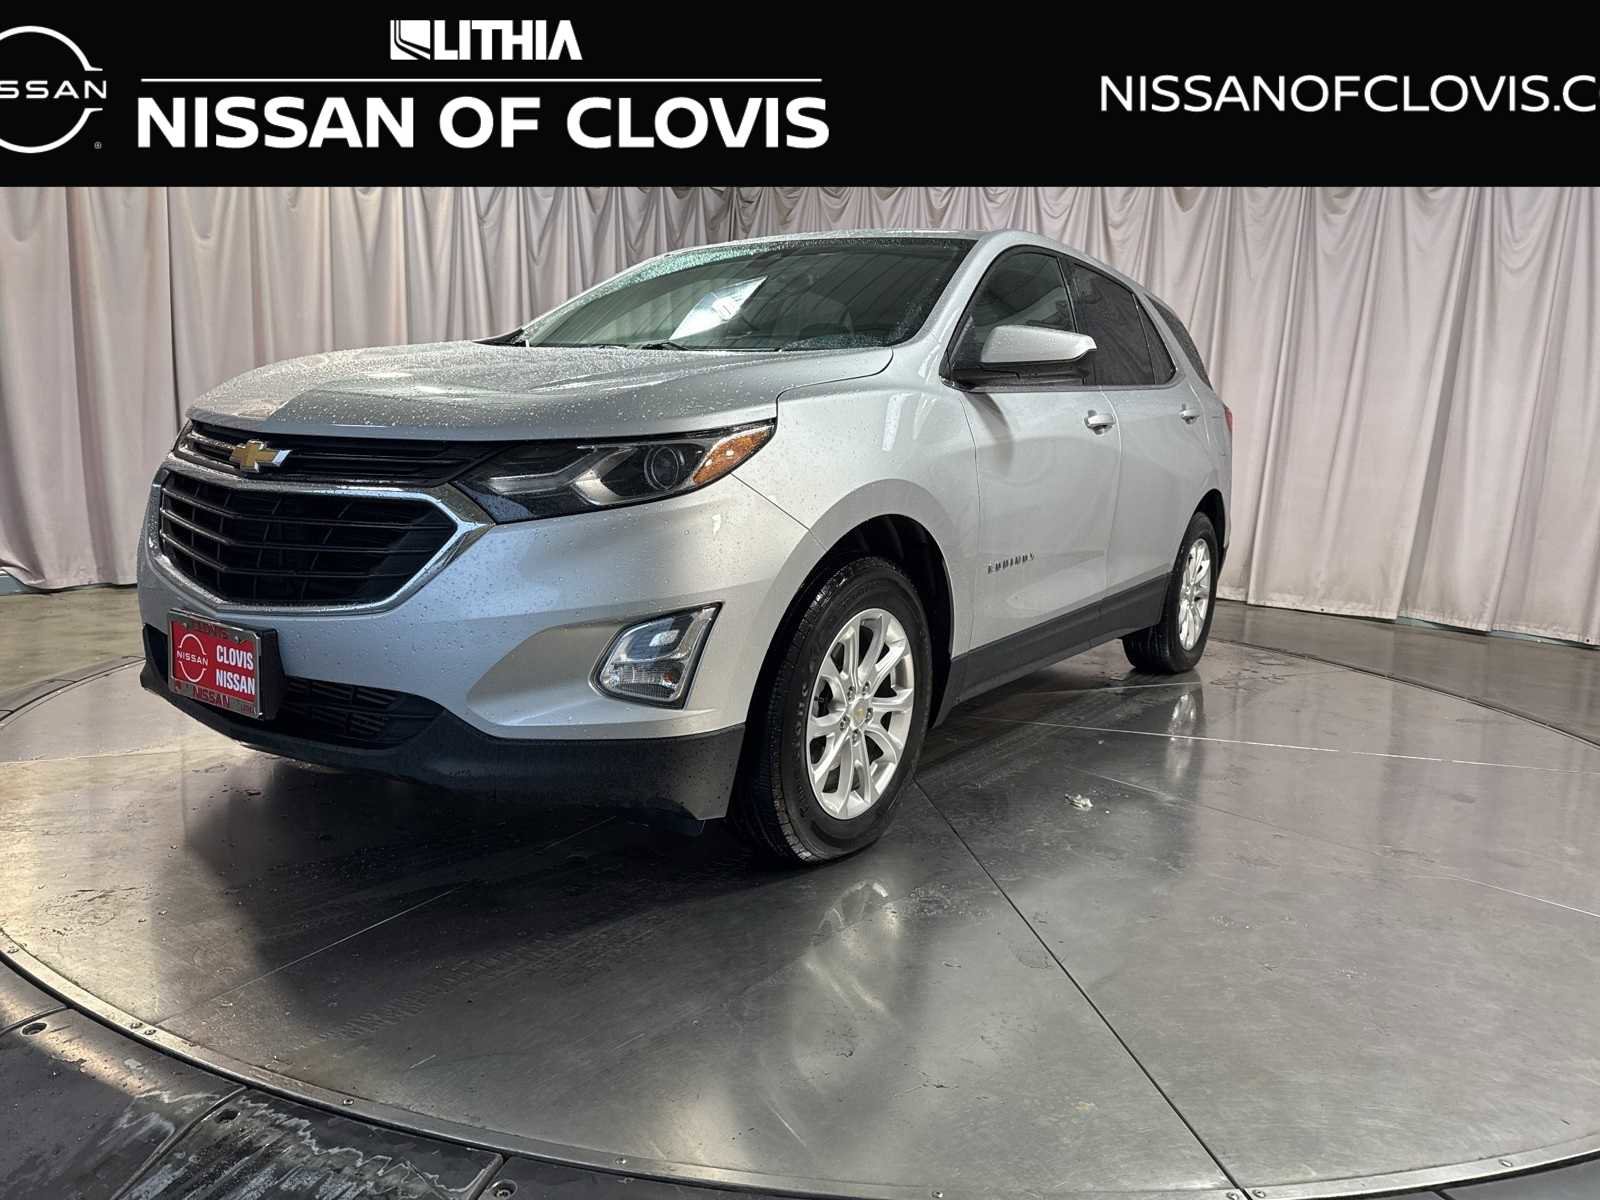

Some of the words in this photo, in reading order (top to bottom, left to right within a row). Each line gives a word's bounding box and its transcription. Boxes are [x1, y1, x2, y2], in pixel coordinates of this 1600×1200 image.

[176, 650, 209, 667] NISSAN
[216, 644, 254, 671] CLOVIS
[215, 668, 256, 696] NISSAN
[192, 685, 230, 707] NISSAN
